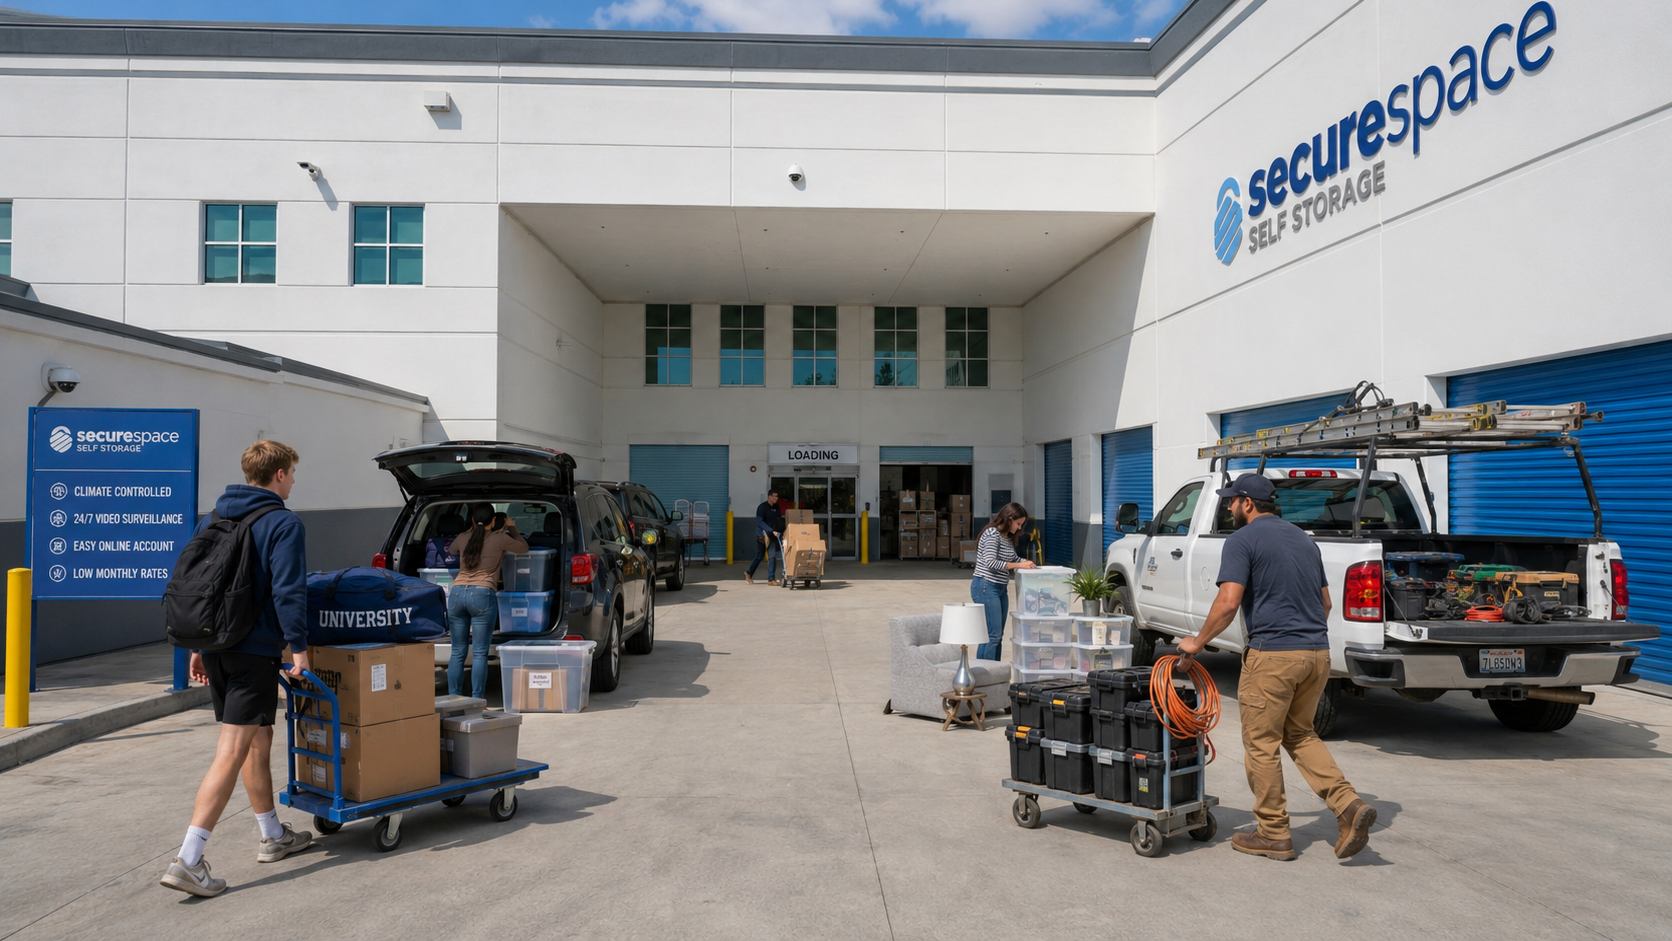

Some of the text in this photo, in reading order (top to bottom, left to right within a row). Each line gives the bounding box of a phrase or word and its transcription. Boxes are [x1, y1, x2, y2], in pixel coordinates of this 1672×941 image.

[1247, 0, 1557, 219] securespace
[1248, 160, 1386, 254] SELF STORAGE
[76, 431, 180, 446] securespace
[76, 444, 142, 453] SELF STORAGE
[788, 450, 839, 461] LOADING
[74, 486, 172, 497] CLIMATE CONTROLLED
[73, 513, 183, 525] 24/7 VIDEO SURVEILLANCE
[73, 540, 174, 552] EASY ONLINE ACCOUNT
[73, 568, 168, 579] LOW MONTHLY RATES
[319, 607, 413, 628] UNIVERSITY
